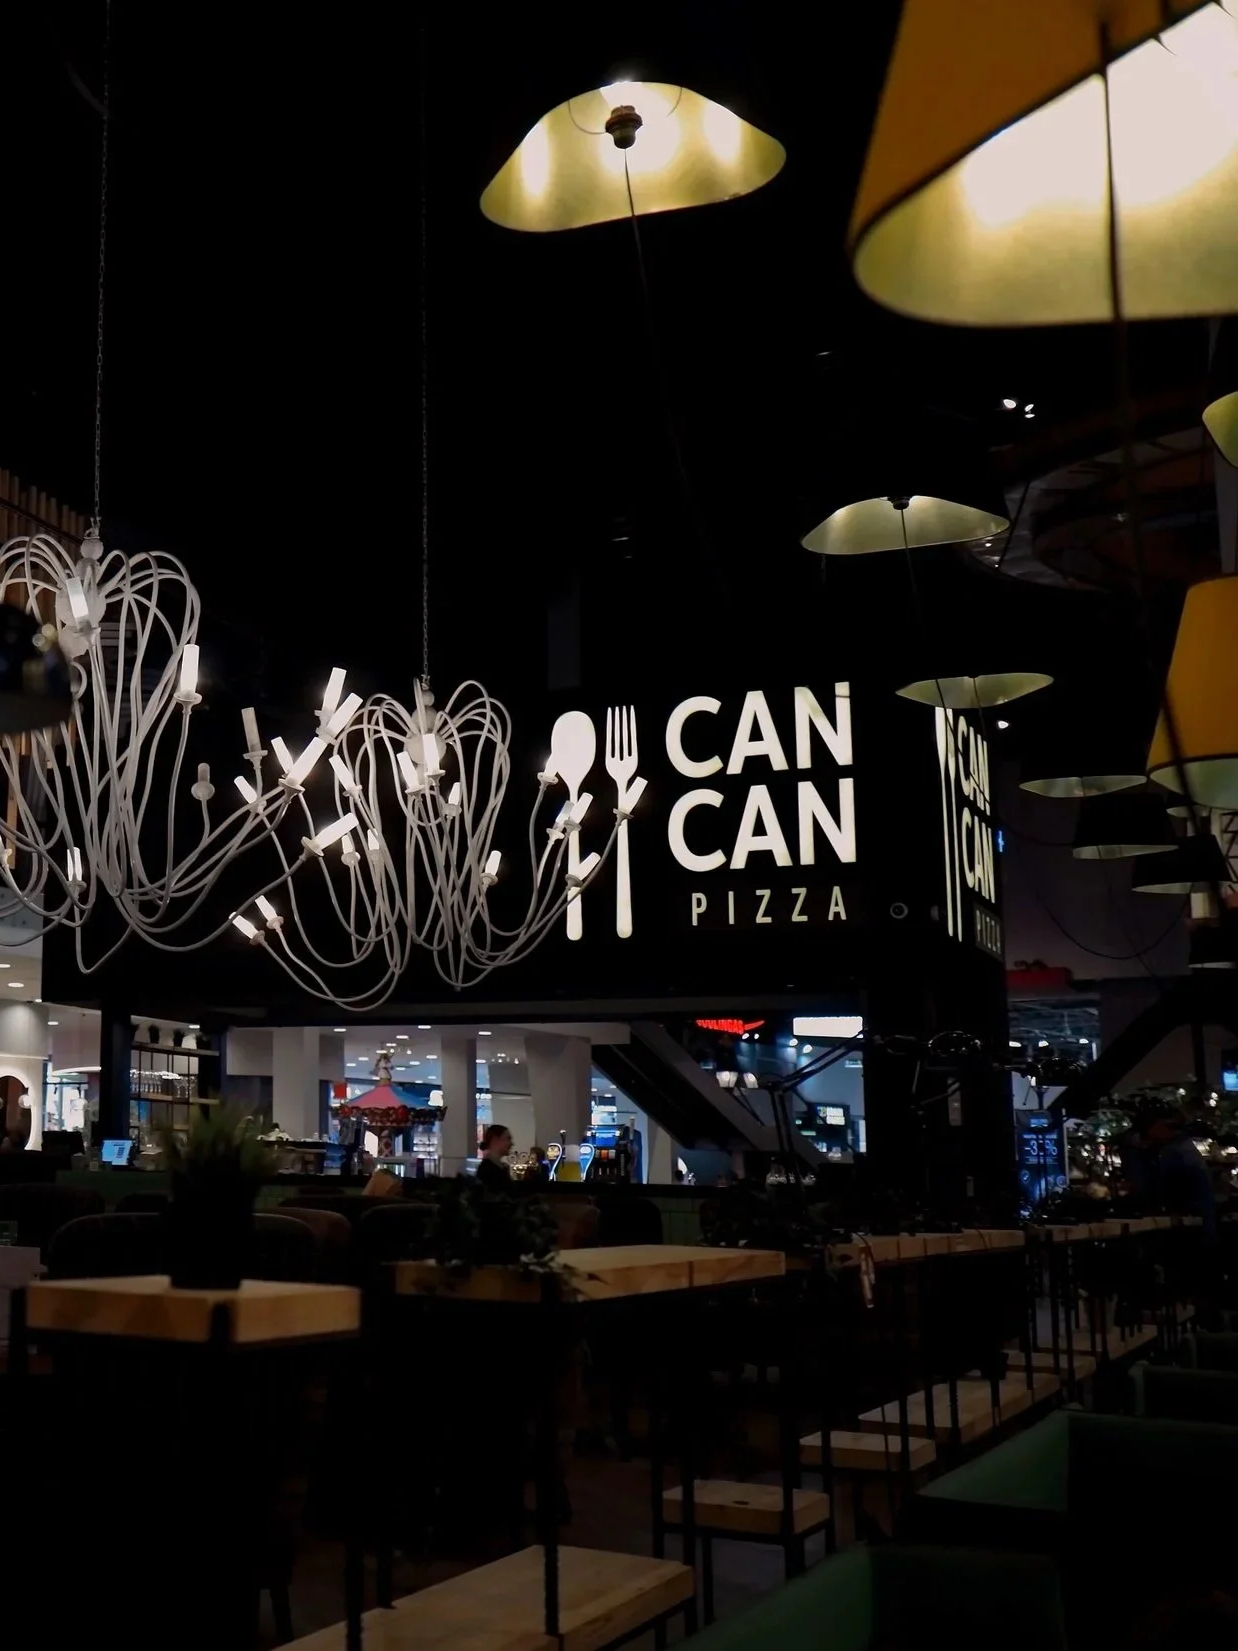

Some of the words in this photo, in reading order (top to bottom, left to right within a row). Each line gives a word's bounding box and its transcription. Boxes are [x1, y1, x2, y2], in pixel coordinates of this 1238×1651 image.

[665, 681, 853, 779] CAN
[957, 714, 991, 817] CAN
[667, 777, 857, 873] CAN
[961, 806, 996, 905] CAN
[691, 885, 847, 926] PIZZA
[975, 909, 1001, 955] PIZZA
